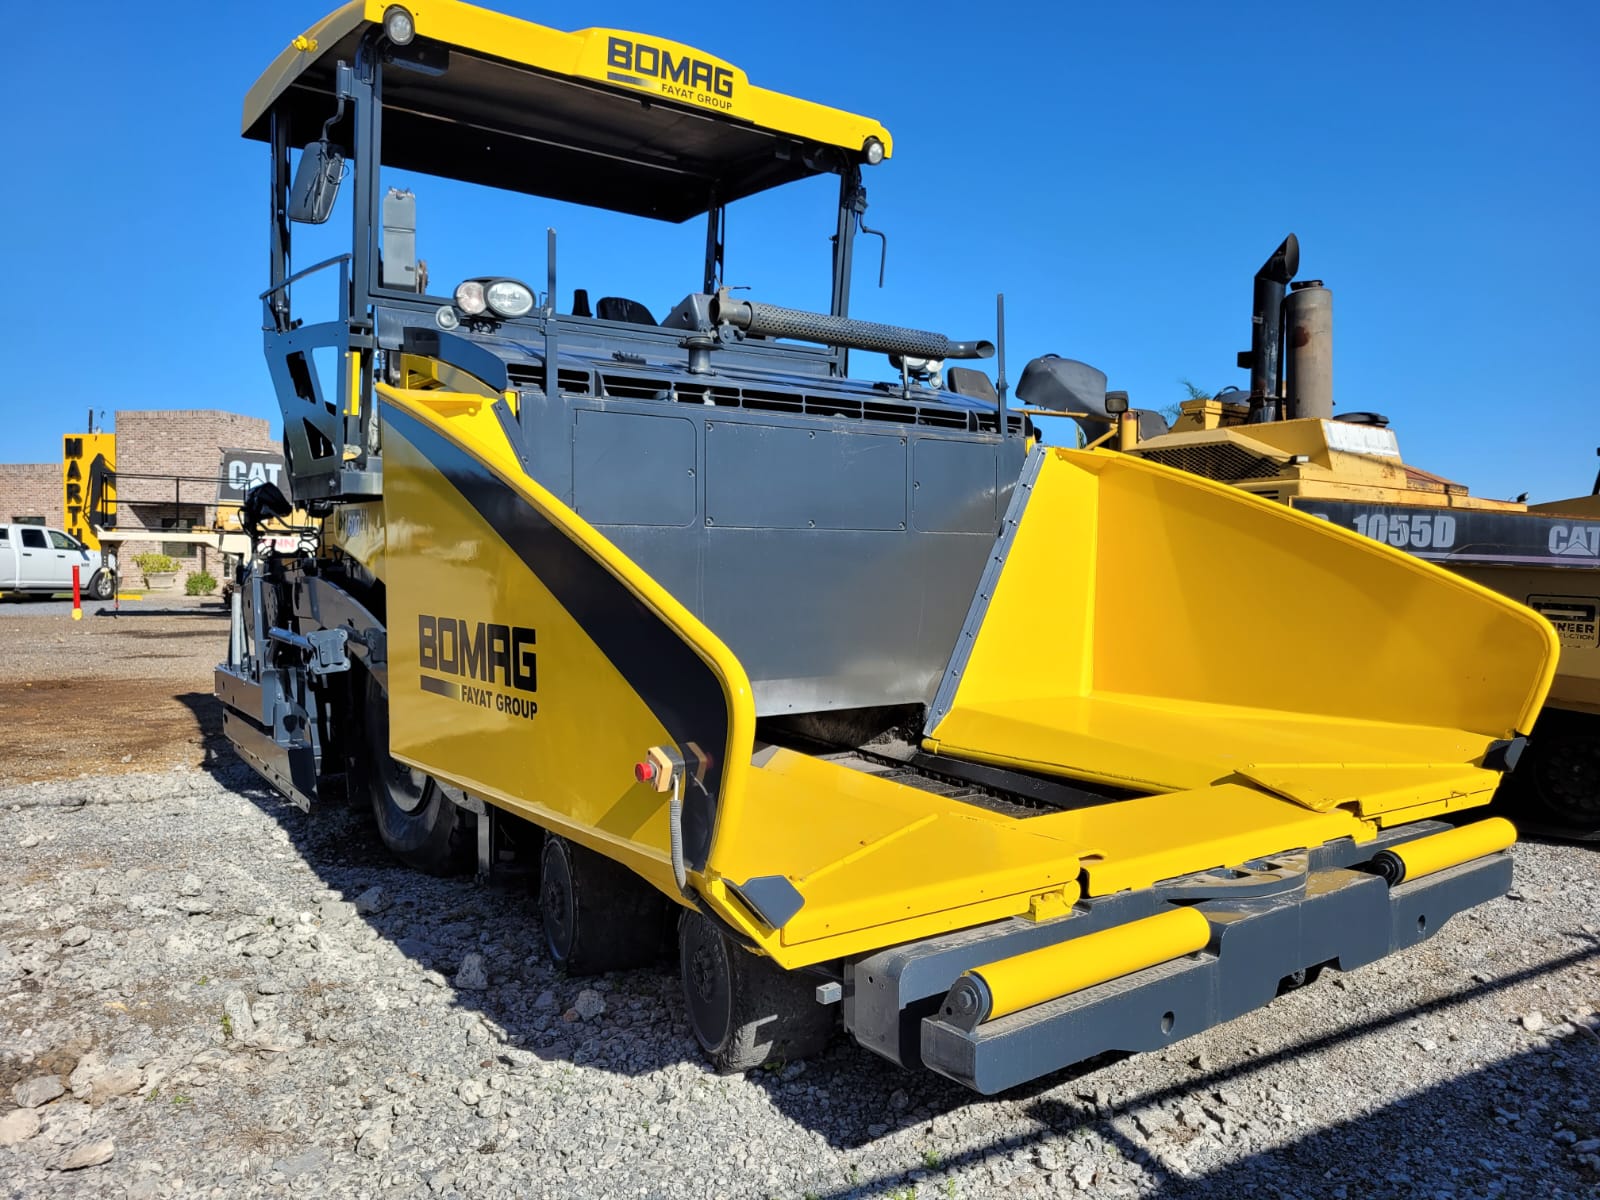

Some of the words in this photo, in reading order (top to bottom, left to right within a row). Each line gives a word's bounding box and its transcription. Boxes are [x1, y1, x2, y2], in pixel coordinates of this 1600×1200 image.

[608, 36, 733, 98] BOMAG
[661, 83, 694, 100] FAYAT
[697, 94, 733, 110] GROUP
[229, 460, 282, 490] CAT
[1353, 513, 1456, 548] 1055D
[1548, 525, 1600, 556] CAT
[1553, 622, 1595, 634] NEER
[418, 614, 537, 693] BOMAG
[461, 685, 493, 709] FAYAT
[496, 693, 538, 721] GROUP
